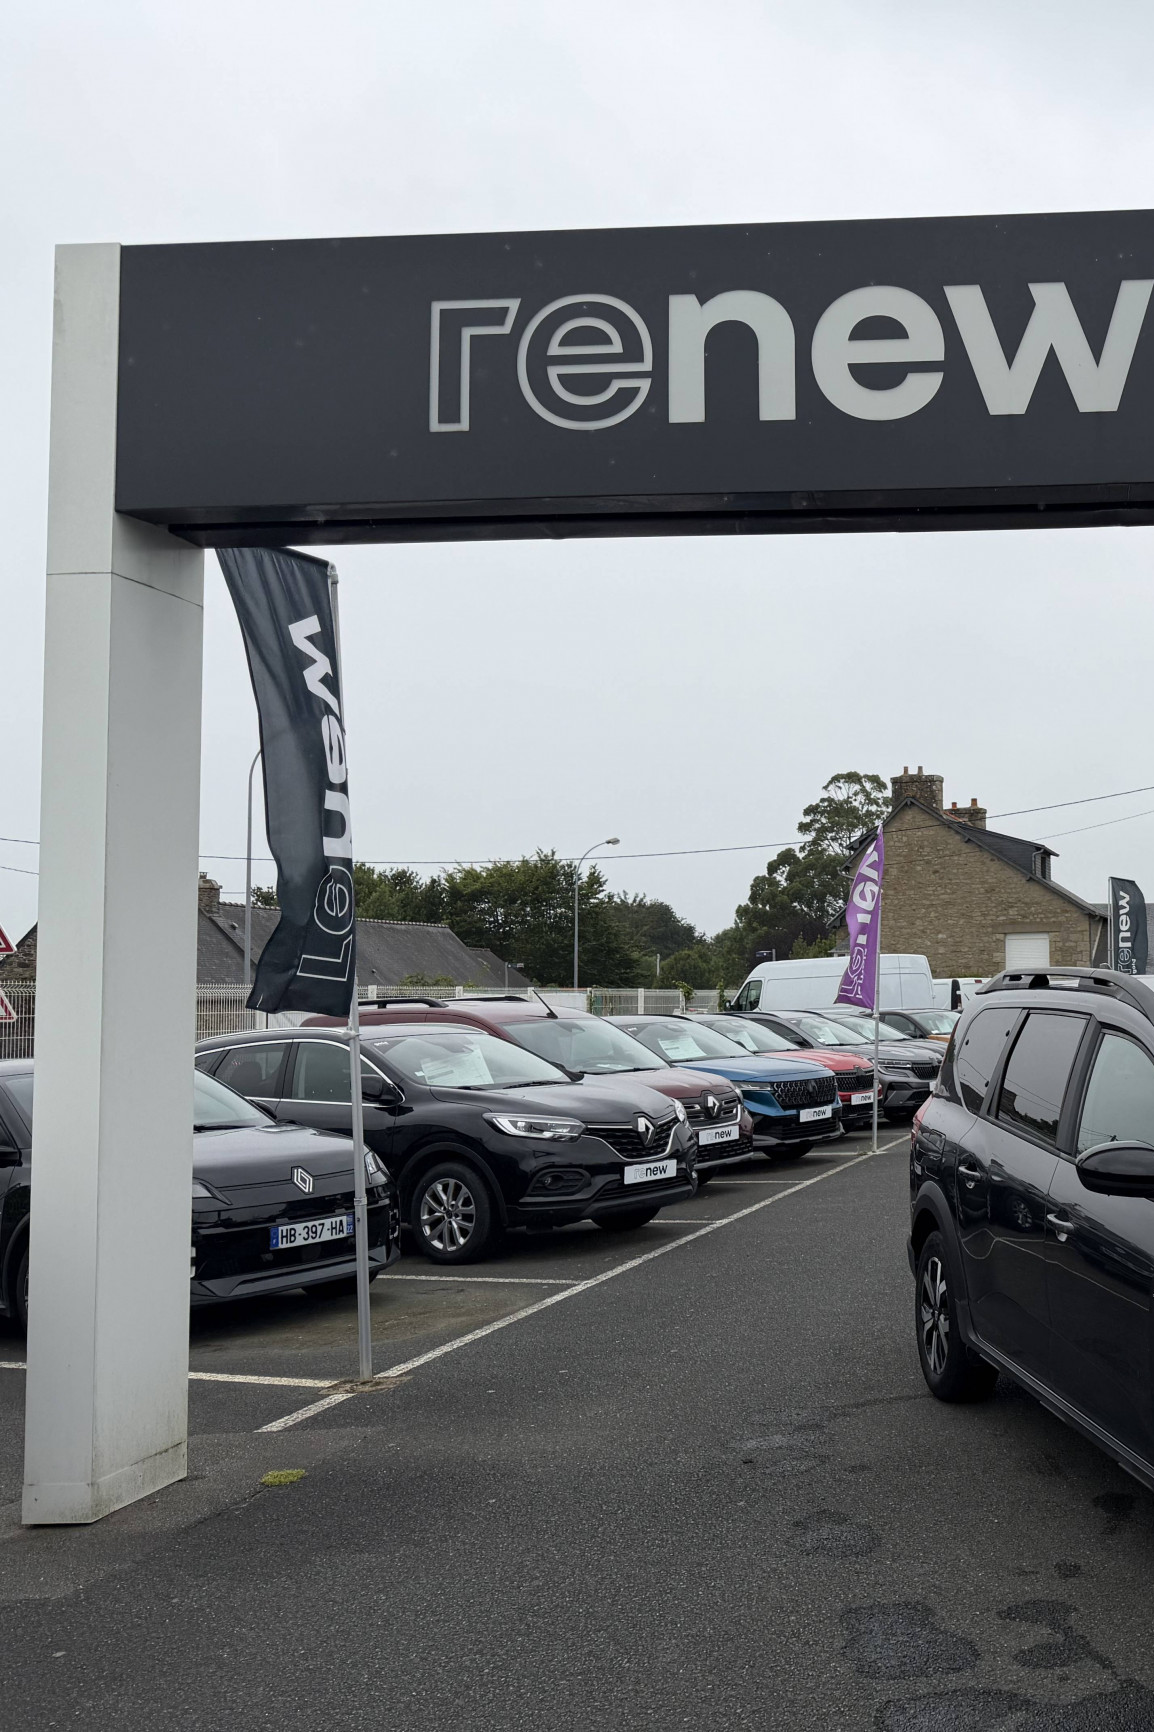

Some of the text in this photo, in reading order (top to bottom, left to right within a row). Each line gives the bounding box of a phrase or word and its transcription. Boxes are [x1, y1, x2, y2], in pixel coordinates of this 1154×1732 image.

[429, 279, 1154, 433] renew
[1118, 890, 1132, 975] renew
[633, 1164, 668, 1180] renew
[280, 1219, 345, 1245] HB-397-HA
